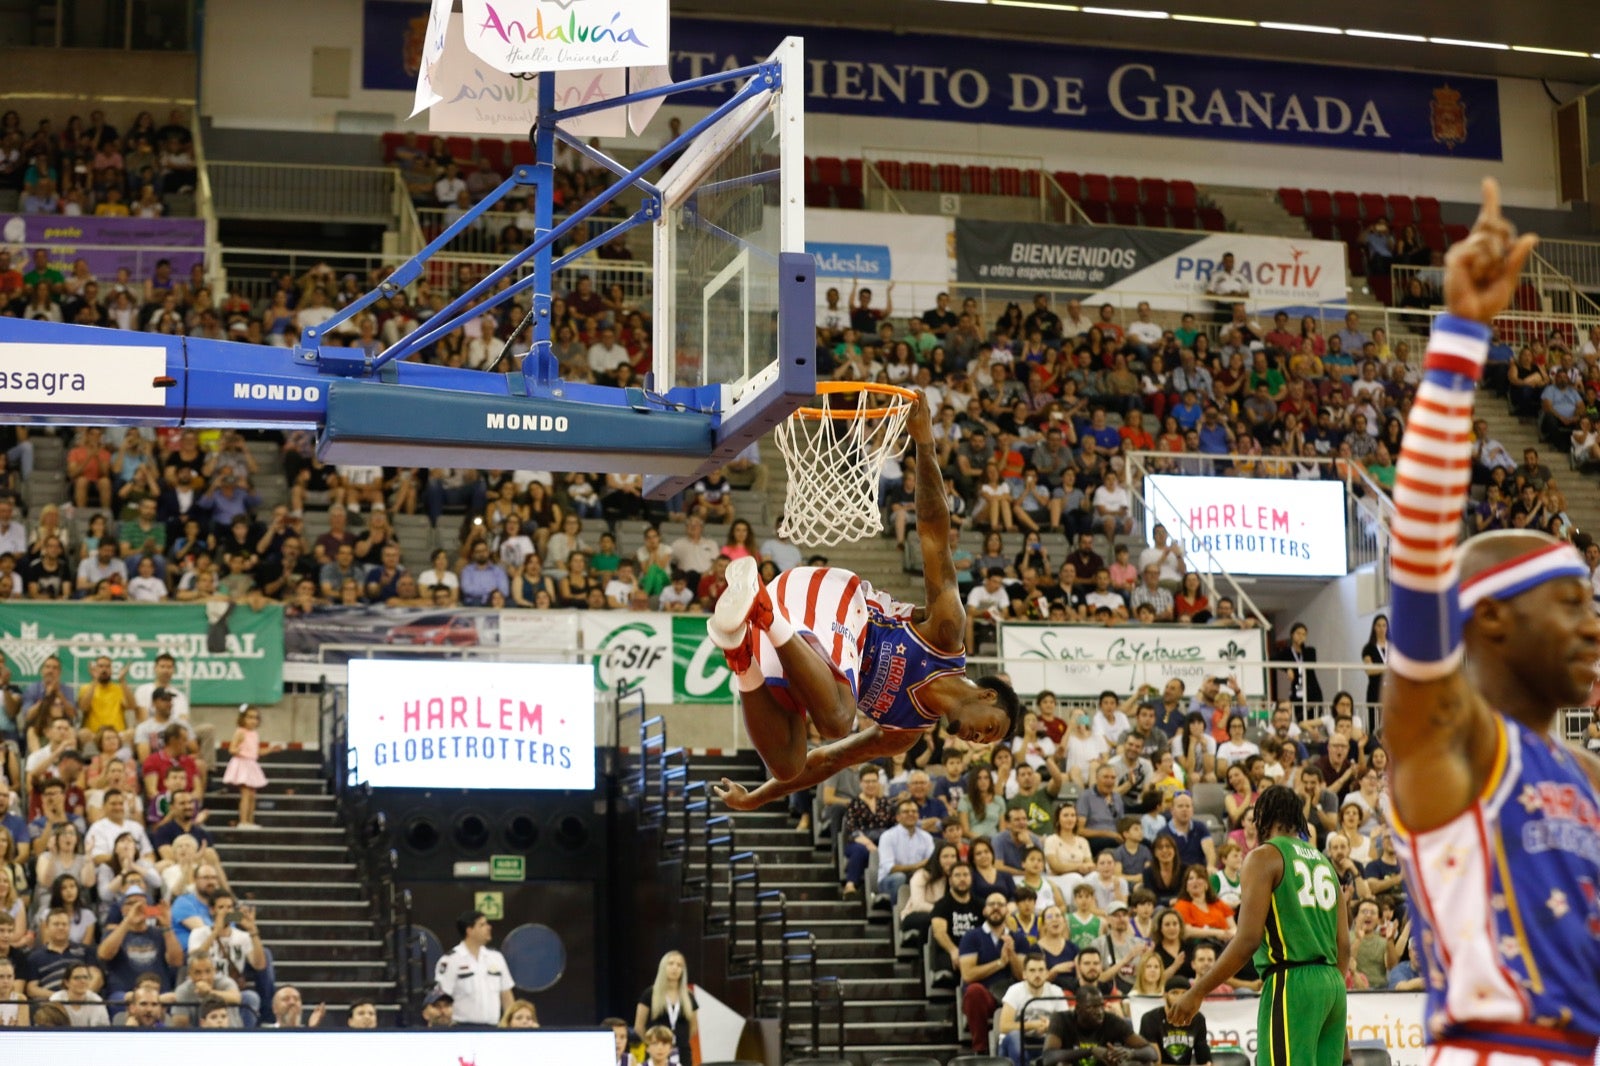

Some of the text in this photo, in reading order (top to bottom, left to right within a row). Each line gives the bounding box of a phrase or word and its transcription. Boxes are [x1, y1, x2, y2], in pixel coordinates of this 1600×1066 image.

[479, 2, 649, 48] Andalucía
[506, 49, 619, 64] Huella Universal
[1008, 73, 1087, 115] DE
[1107, 63, 1391, 138] GRANADA
[1010, 243, 1136, 269] BIENVENIDOS
[979, 264, 1105, 282] a otro espectáculo de
[1174, 257, 1321, 288] PRACTIV
[233, 383, 320, 402] MONDO
[486, 413, 569, 432] MONDO
[1189, 504, 1289, 534] HARLEM
[605, 645, 667, 669] CSIF
[872, 655, 907, 713] HARLEM
[404, 696, 542, 735] HARLEM
[375, 736, 572, 769] GLOBETROTTERS
[1292, 859, 1337, 911] 26
